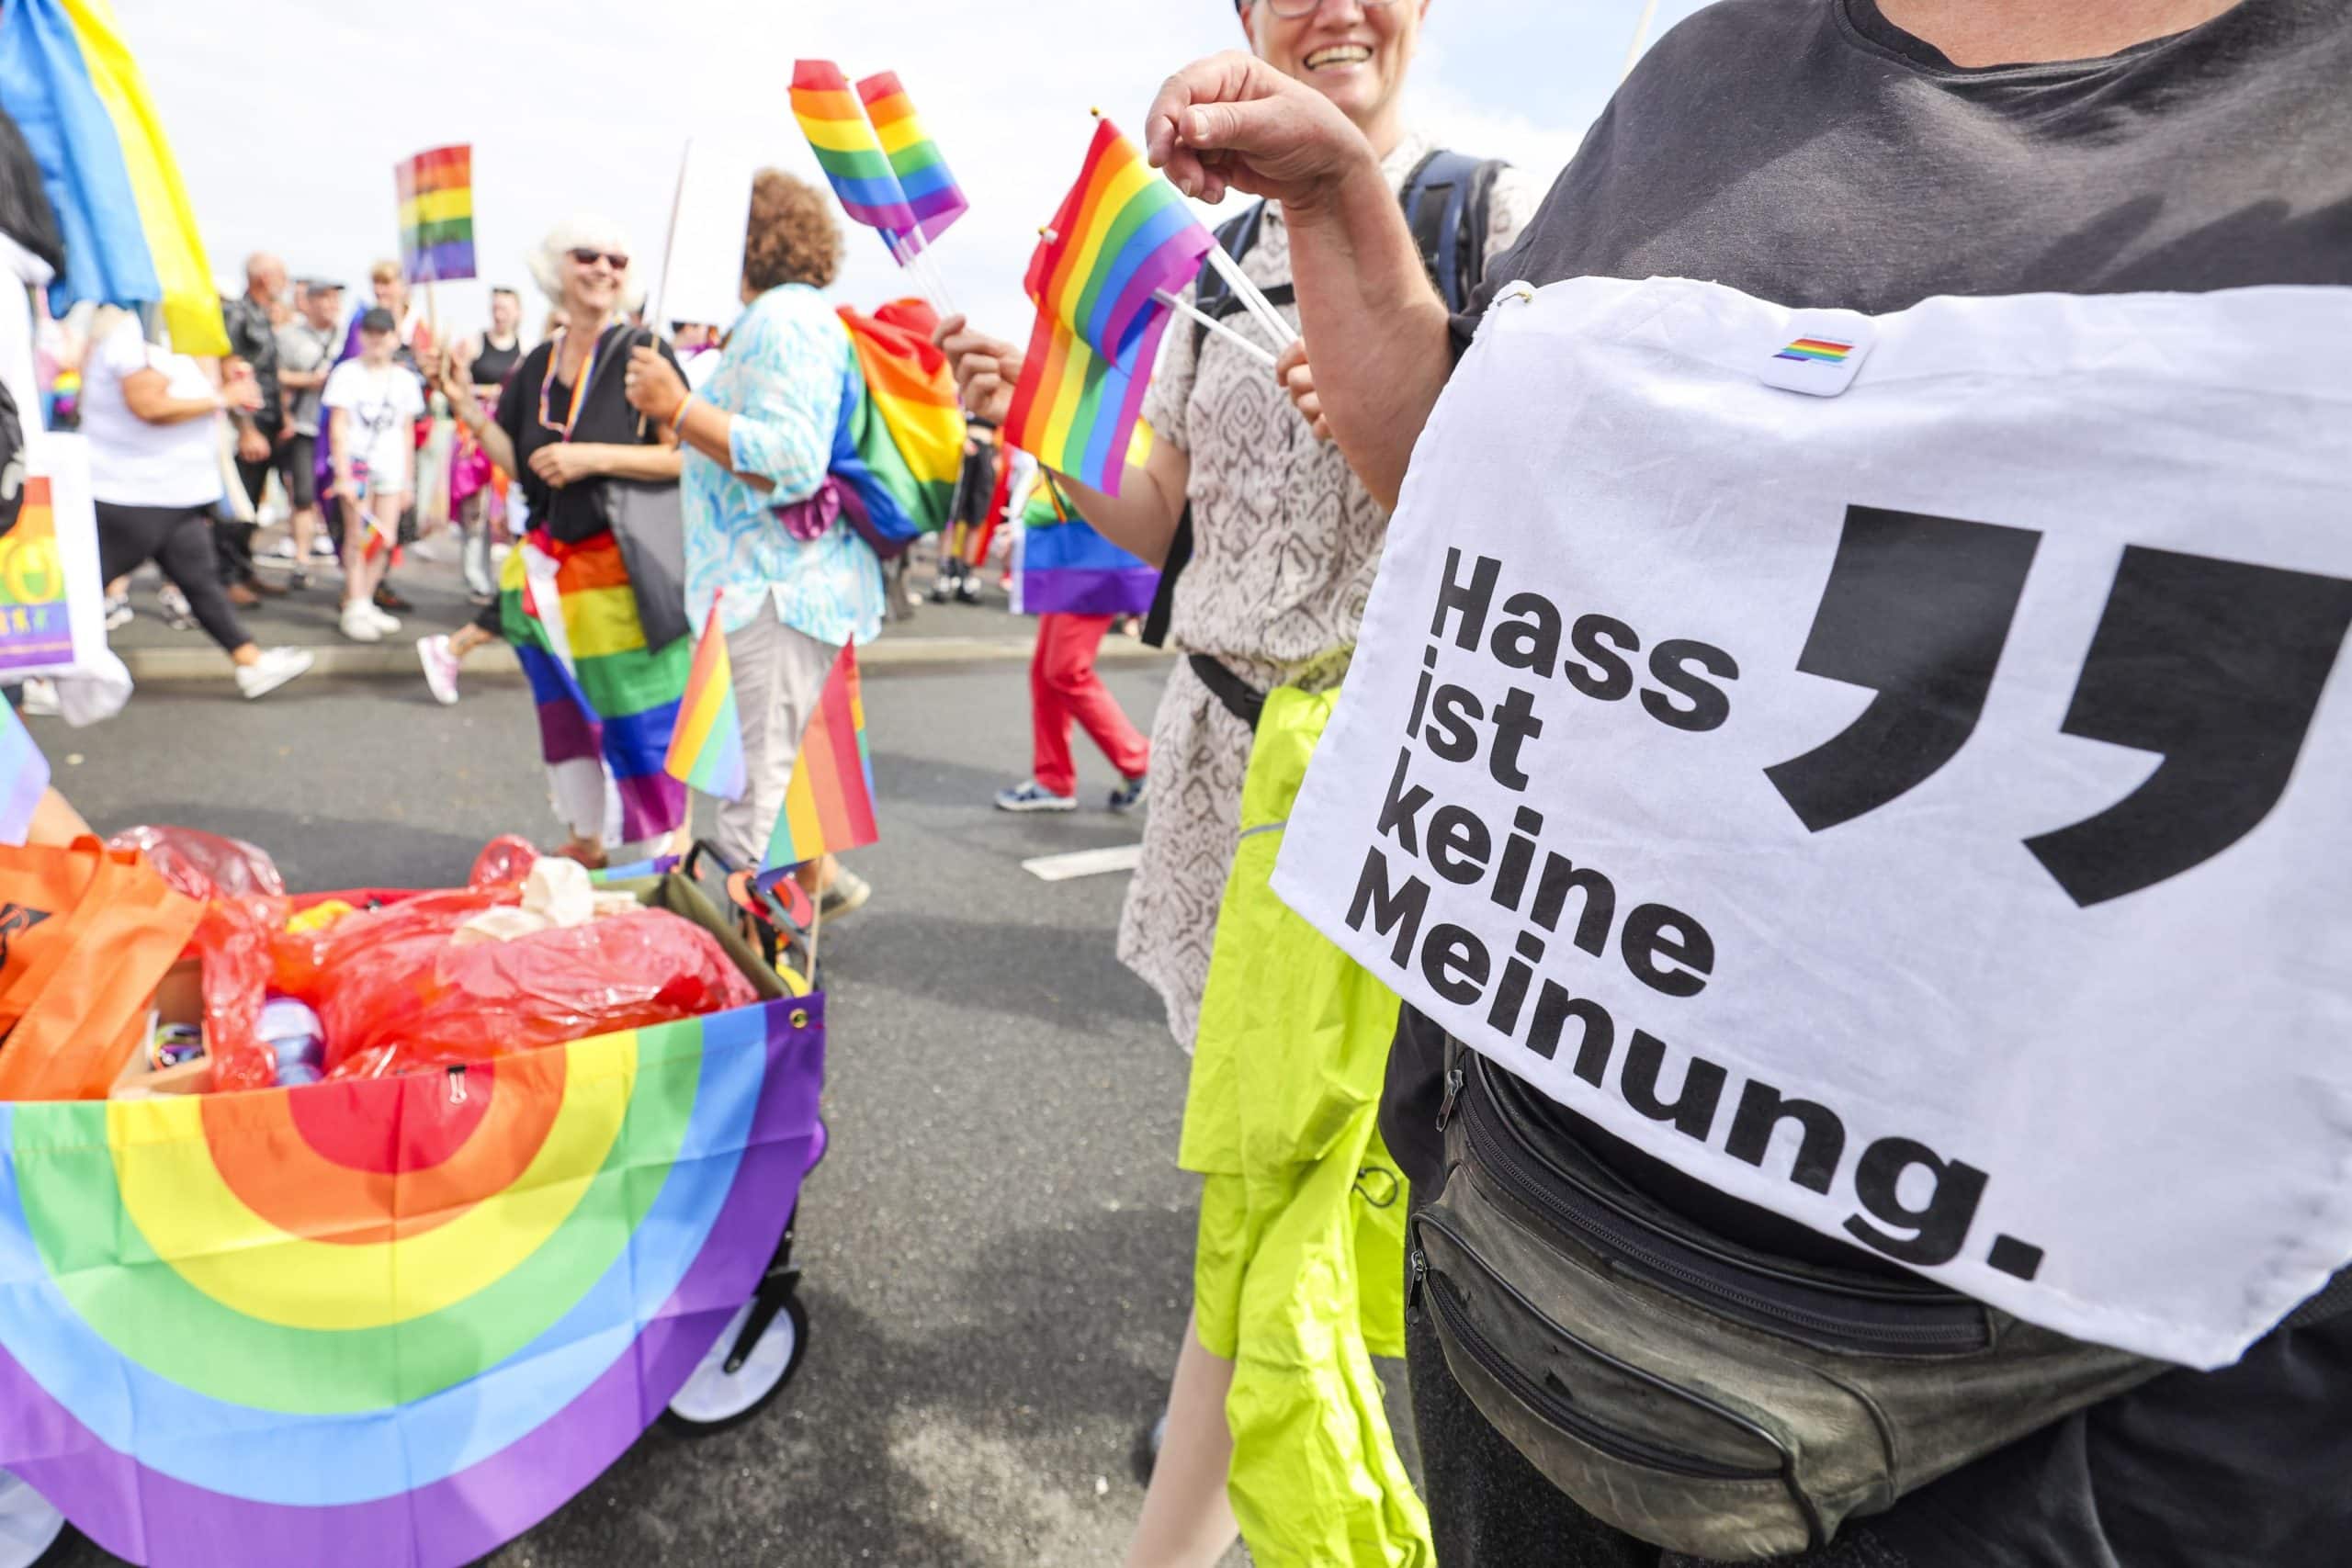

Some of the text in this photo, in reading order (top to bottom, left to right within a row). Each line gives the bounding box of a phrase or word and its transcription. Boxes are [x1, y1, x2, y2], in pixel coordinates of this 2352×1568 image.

[1407, 645, 1543, 791] ist
[1430, 547, 1738, 731] Hass
[1377, 747, 1714, 997] keine
[1345, 846, 2043, 1280] Meinung.
